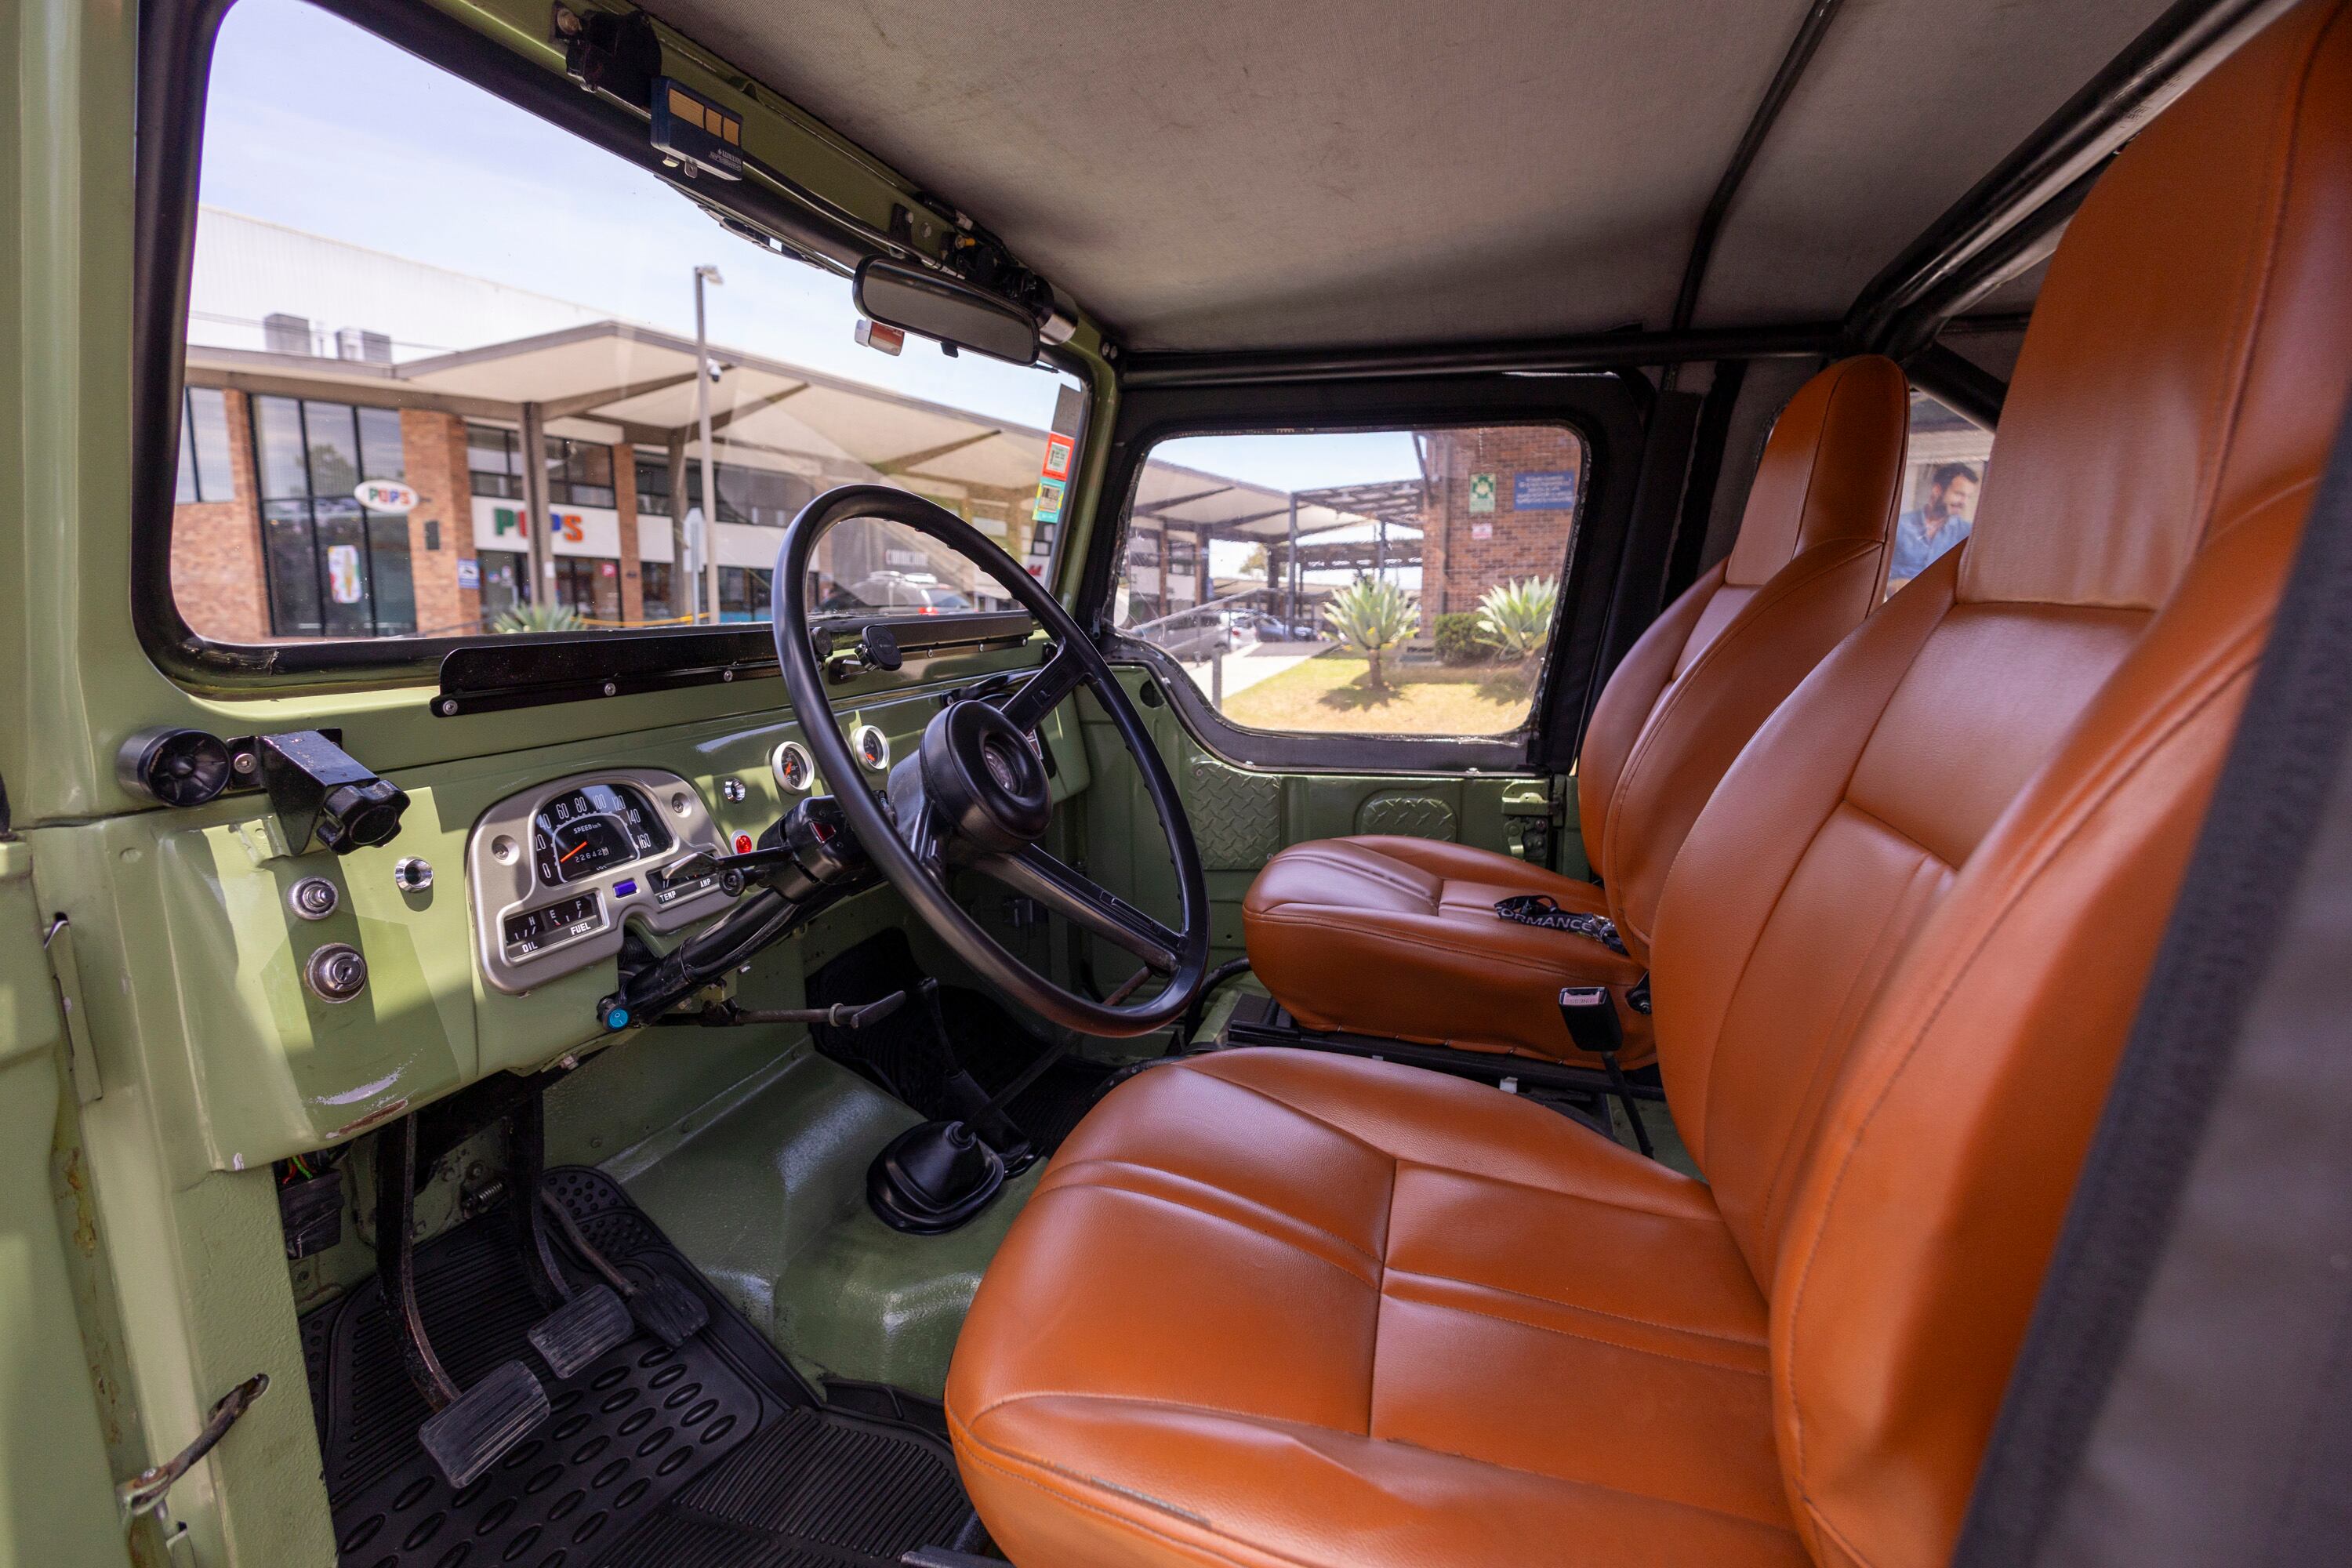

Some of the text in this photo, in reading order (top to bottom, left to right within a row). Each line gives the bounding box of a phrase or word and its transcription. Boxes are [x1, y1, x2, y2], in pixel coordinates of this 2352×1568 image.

[368, 488, 410, 506] POPS
[574, 797, 587, 813] 80
[593, 793, 607, 811] 100
[612, 795, 626, 811] 120
[556, 803, 570, 820] 60
[626, 808, 641, 826] 140
[539, 813, 552, 829] 40
[573, 824, 592, 834] SPEED
[535, 833, 546, 851] 20
[637, 833, 652, 849] 160
[542, 862, 551, 878] 0
[699, 878, 711, 888] AMP
[659, 890, 677, 902] TEMP
[575, 900, 582, 909] F
[528, 916, 536, 926] H
[549, 909, 556, 919] E
[570, 922, 592, 935] FUEL
[521, 941, 539, 953] OIL
